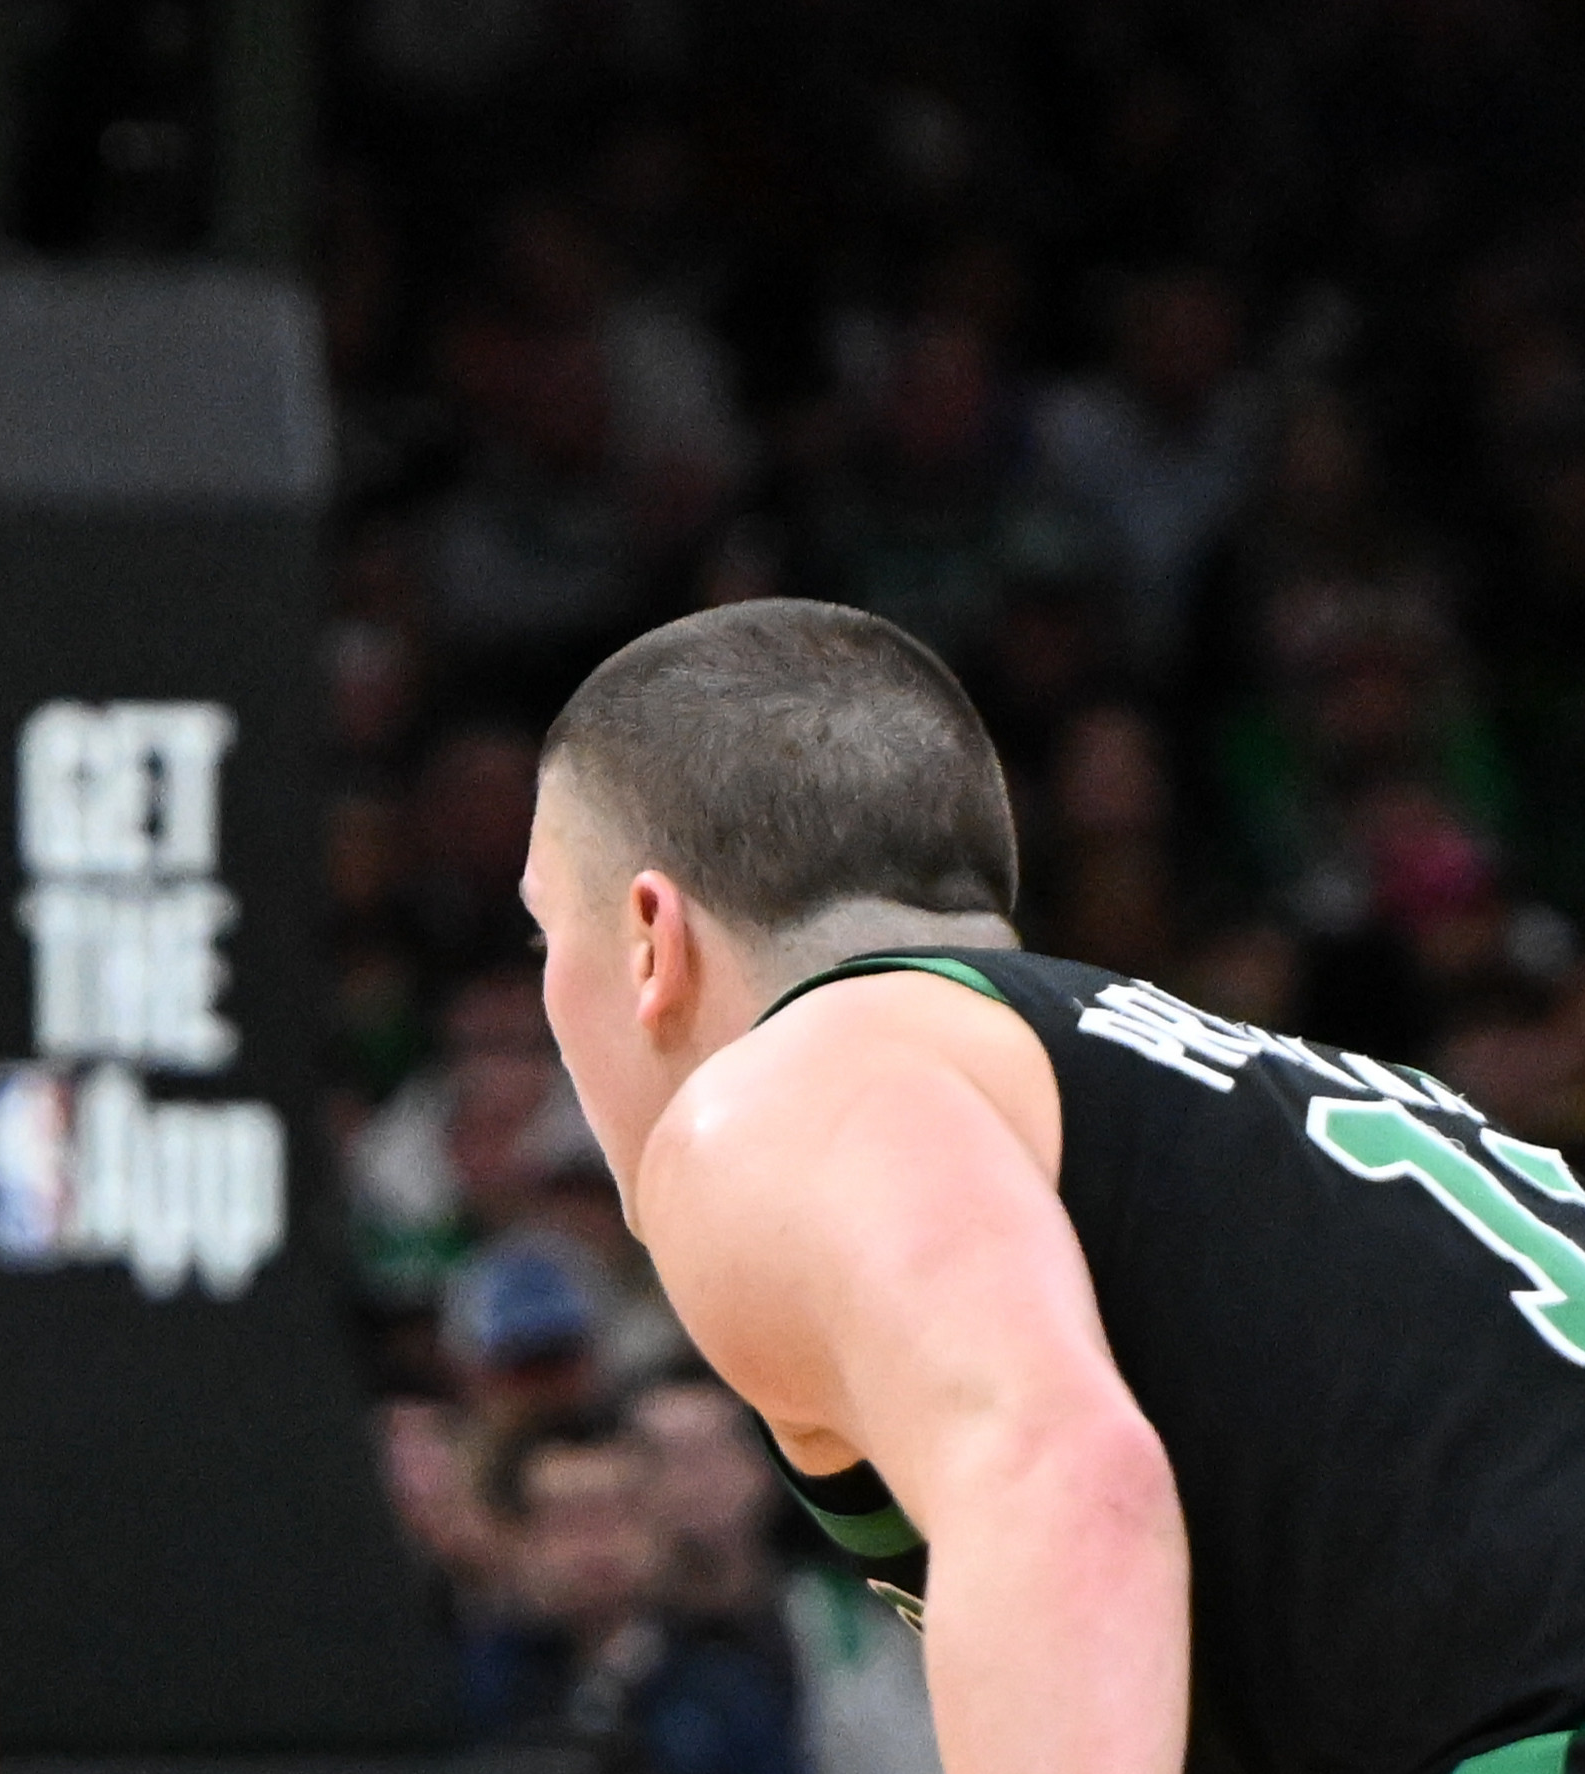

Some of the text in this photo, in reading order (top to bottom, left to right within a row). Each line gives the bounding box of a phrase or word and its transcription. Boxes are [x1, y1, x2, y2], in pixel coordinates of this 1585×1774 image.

[18, 700, 236, 872] GET
[16, 878, 241, 1074] THE
[70, 1064, 288, 1298] App
